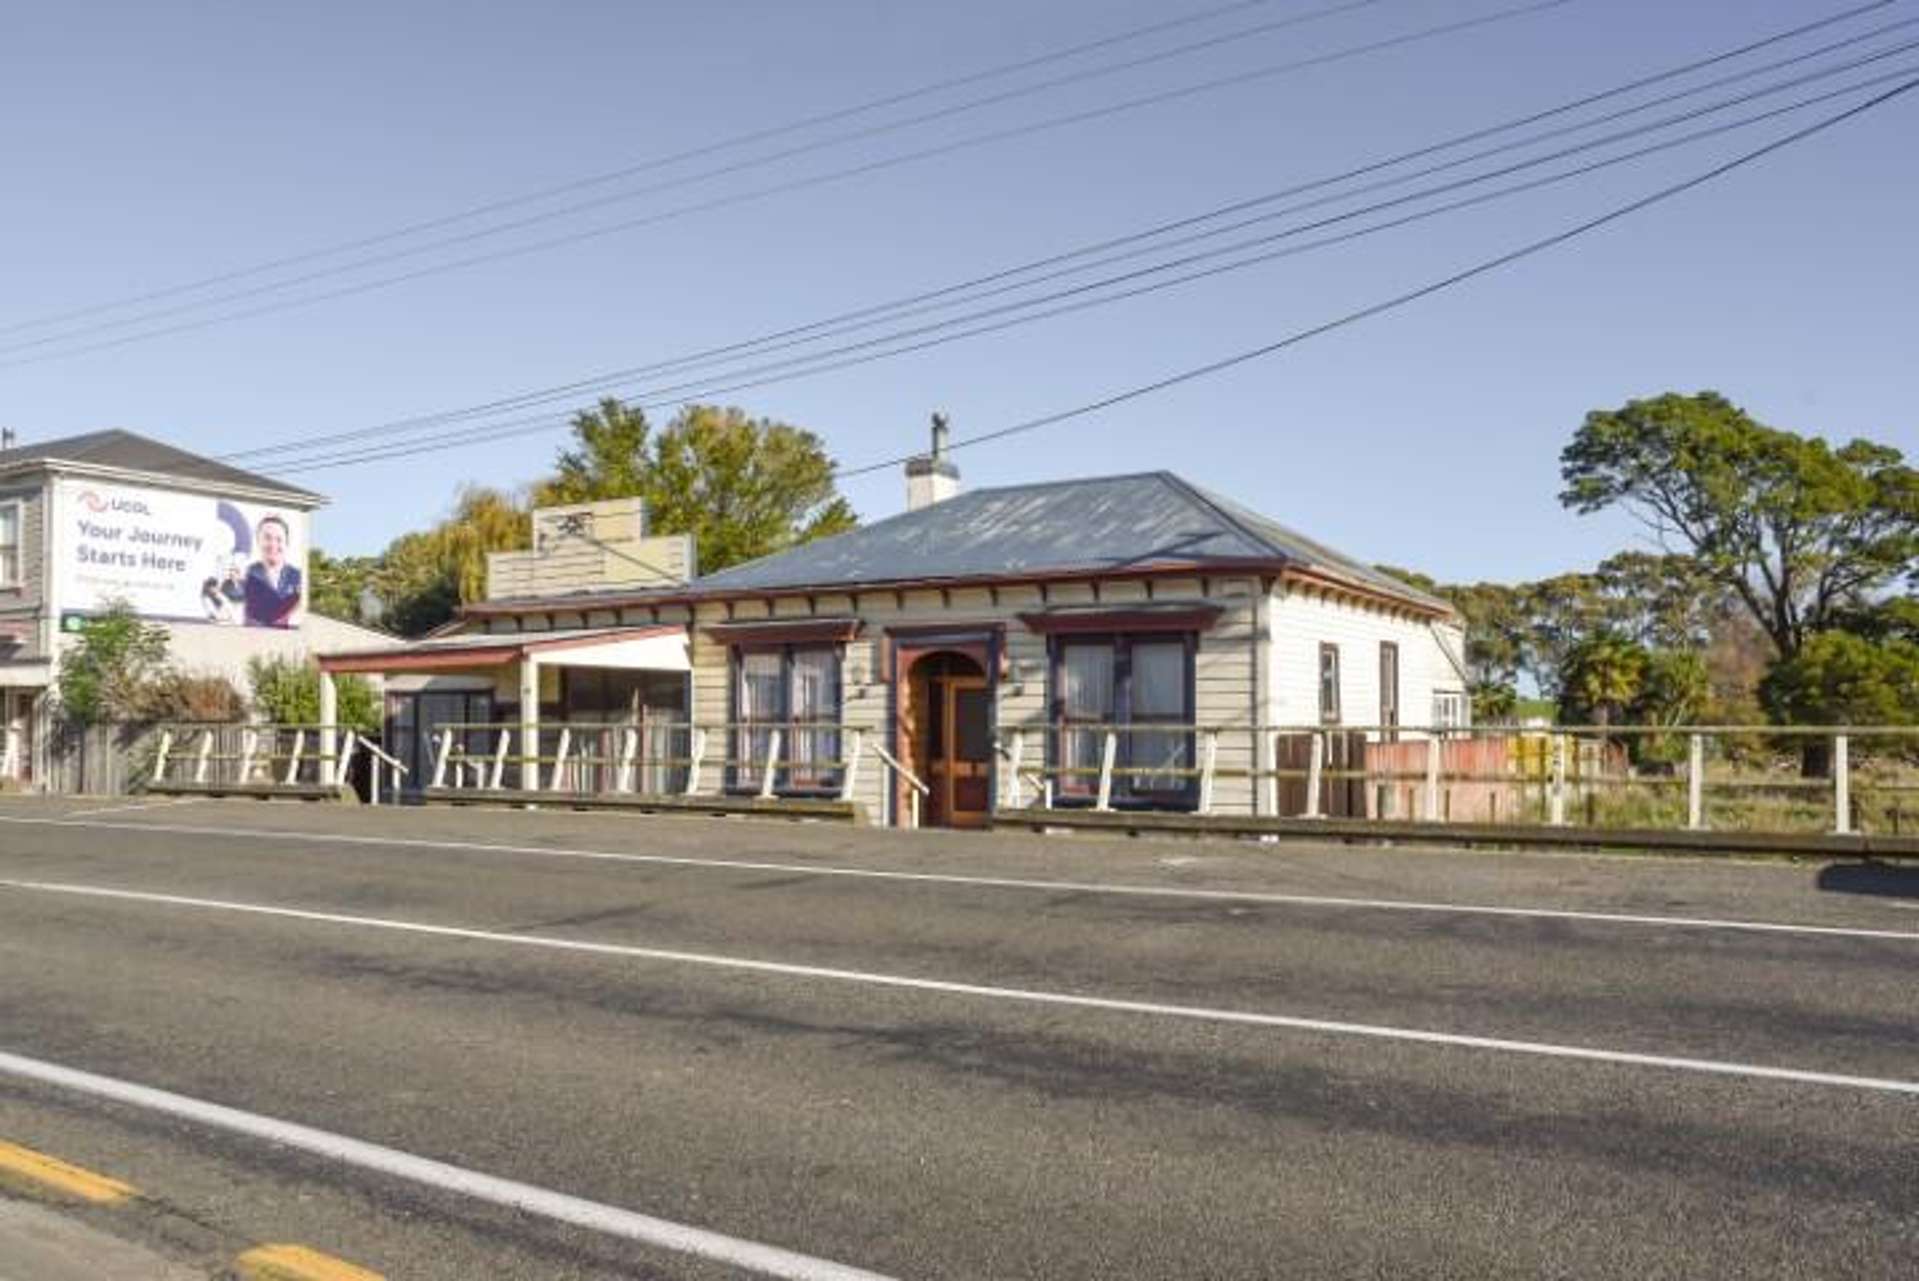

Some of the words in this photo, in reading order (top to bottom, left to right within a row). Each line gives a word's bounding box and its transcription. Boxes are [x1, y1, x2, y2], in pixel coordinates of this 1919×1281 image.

[77, 519, 122, 541] Your
[128, 525, 203, 551] Journey
[76, 544, 137, 567] Starts
[141, 553, 186, 572] Here
